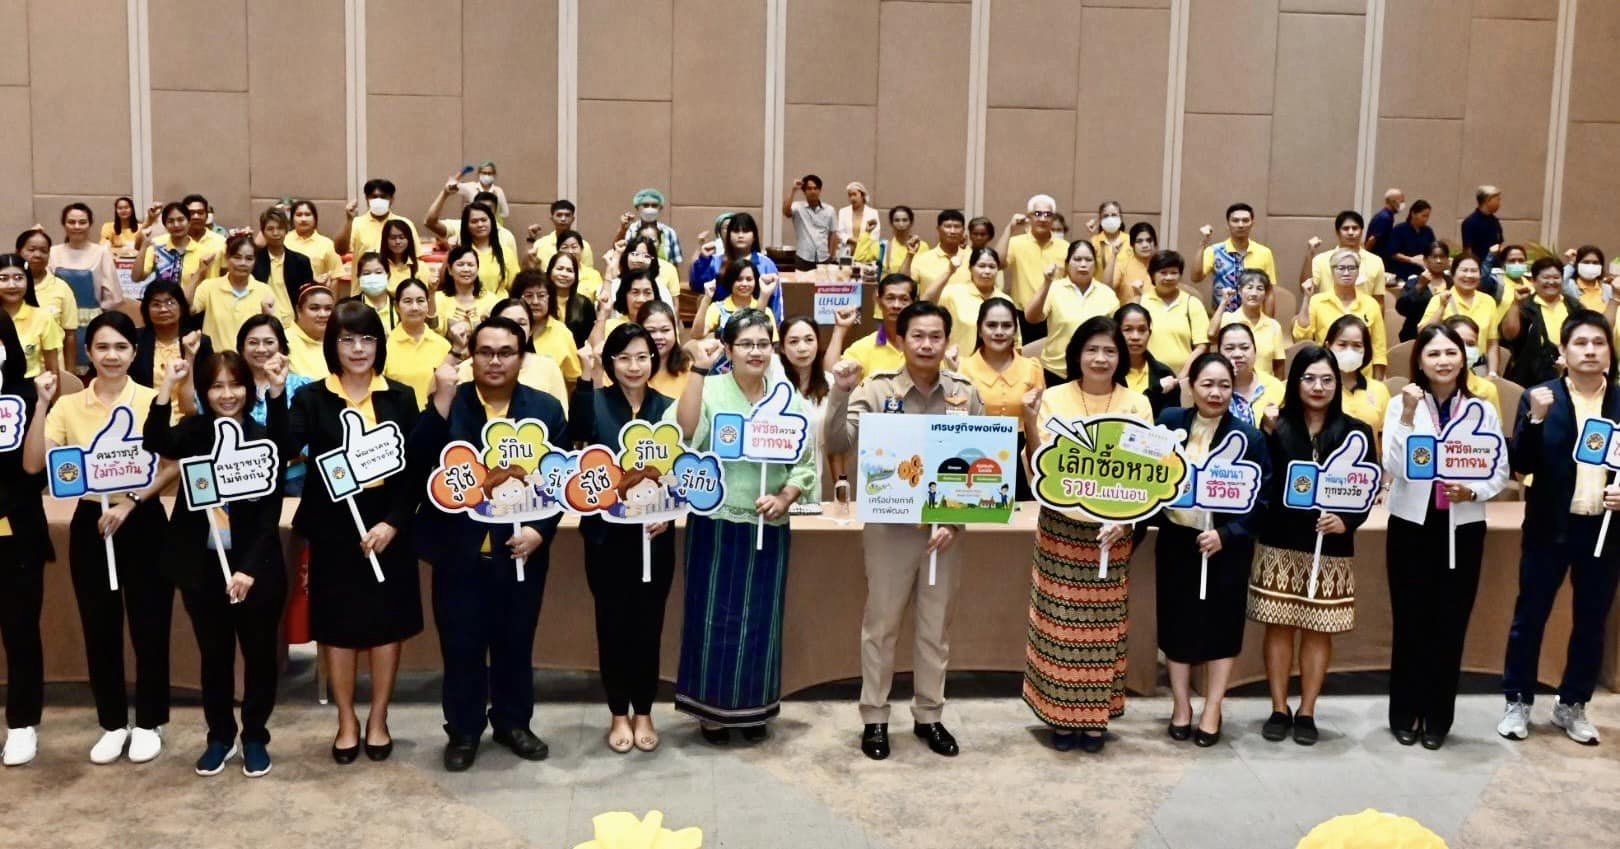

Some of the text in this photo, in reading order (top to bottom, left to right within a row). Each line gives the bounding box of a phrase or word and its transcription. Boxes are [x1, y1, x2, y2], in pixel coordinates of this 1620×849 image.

[930, 422, 1013, 434] เศรษฐกิจพอเพียง
[96, 445, 140, 460] คนราชบุรี
[498, 438, 534, 467] รู้กิน
[752, 437, 794, 449] ยากจน
[216, 453, 268, 470] คนราชบุรี
[634, 439, 668, 468] รู้กิน
[1445, 457, 1488, 469] ยากจน
[91, 460, 142, 479] ไม่ทิ้งกัน
[1057, 443, 1170, 484] เลิกซื้อหวย
[1209, 464, 1244, 480] พัฒนา
[445, 463, 476, 502] รู้ใช้
[580, 466, 611, 504] รู้ใช้
[678, 469, 717, 496] รู้เก็บ
[1206, 480, 1240, 499] ชีวิต
[872, 505, 910, 515] การพัฒนา
